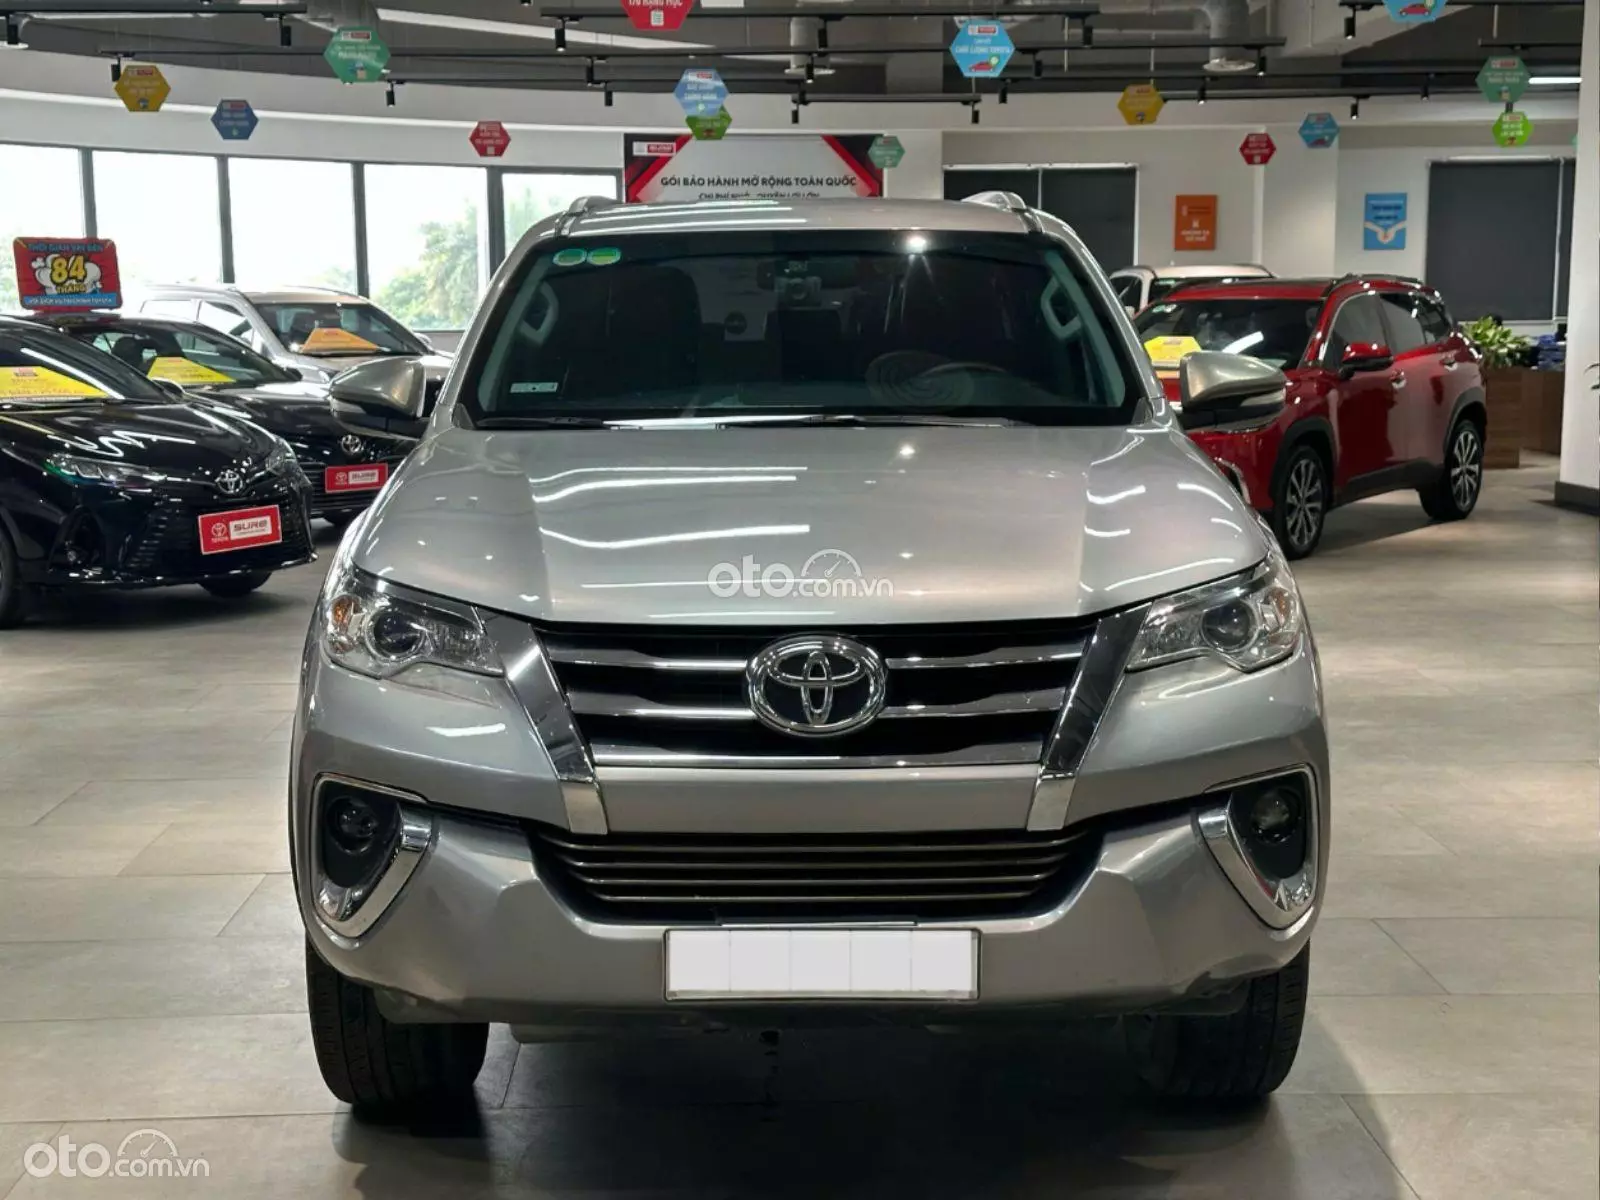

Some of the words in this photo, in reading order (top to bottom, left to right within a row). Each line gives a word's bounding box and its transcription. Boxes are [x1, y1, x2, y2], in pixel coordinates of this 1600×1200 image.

[661, 175, 680, 186] GÓI
[683, 175, 705, 186] BẢO
[708, 175, 739, 186] HÀNH
[741, 174, 759, 186] MỞ
[761, 174, 792, 188] RỘNG
[795, 174, 823, 186] TOÀN
[825, 174, 857, 187] QUỐC
[51, 254, 87, 285] 84
[234, 519, 267, 532] SURE
